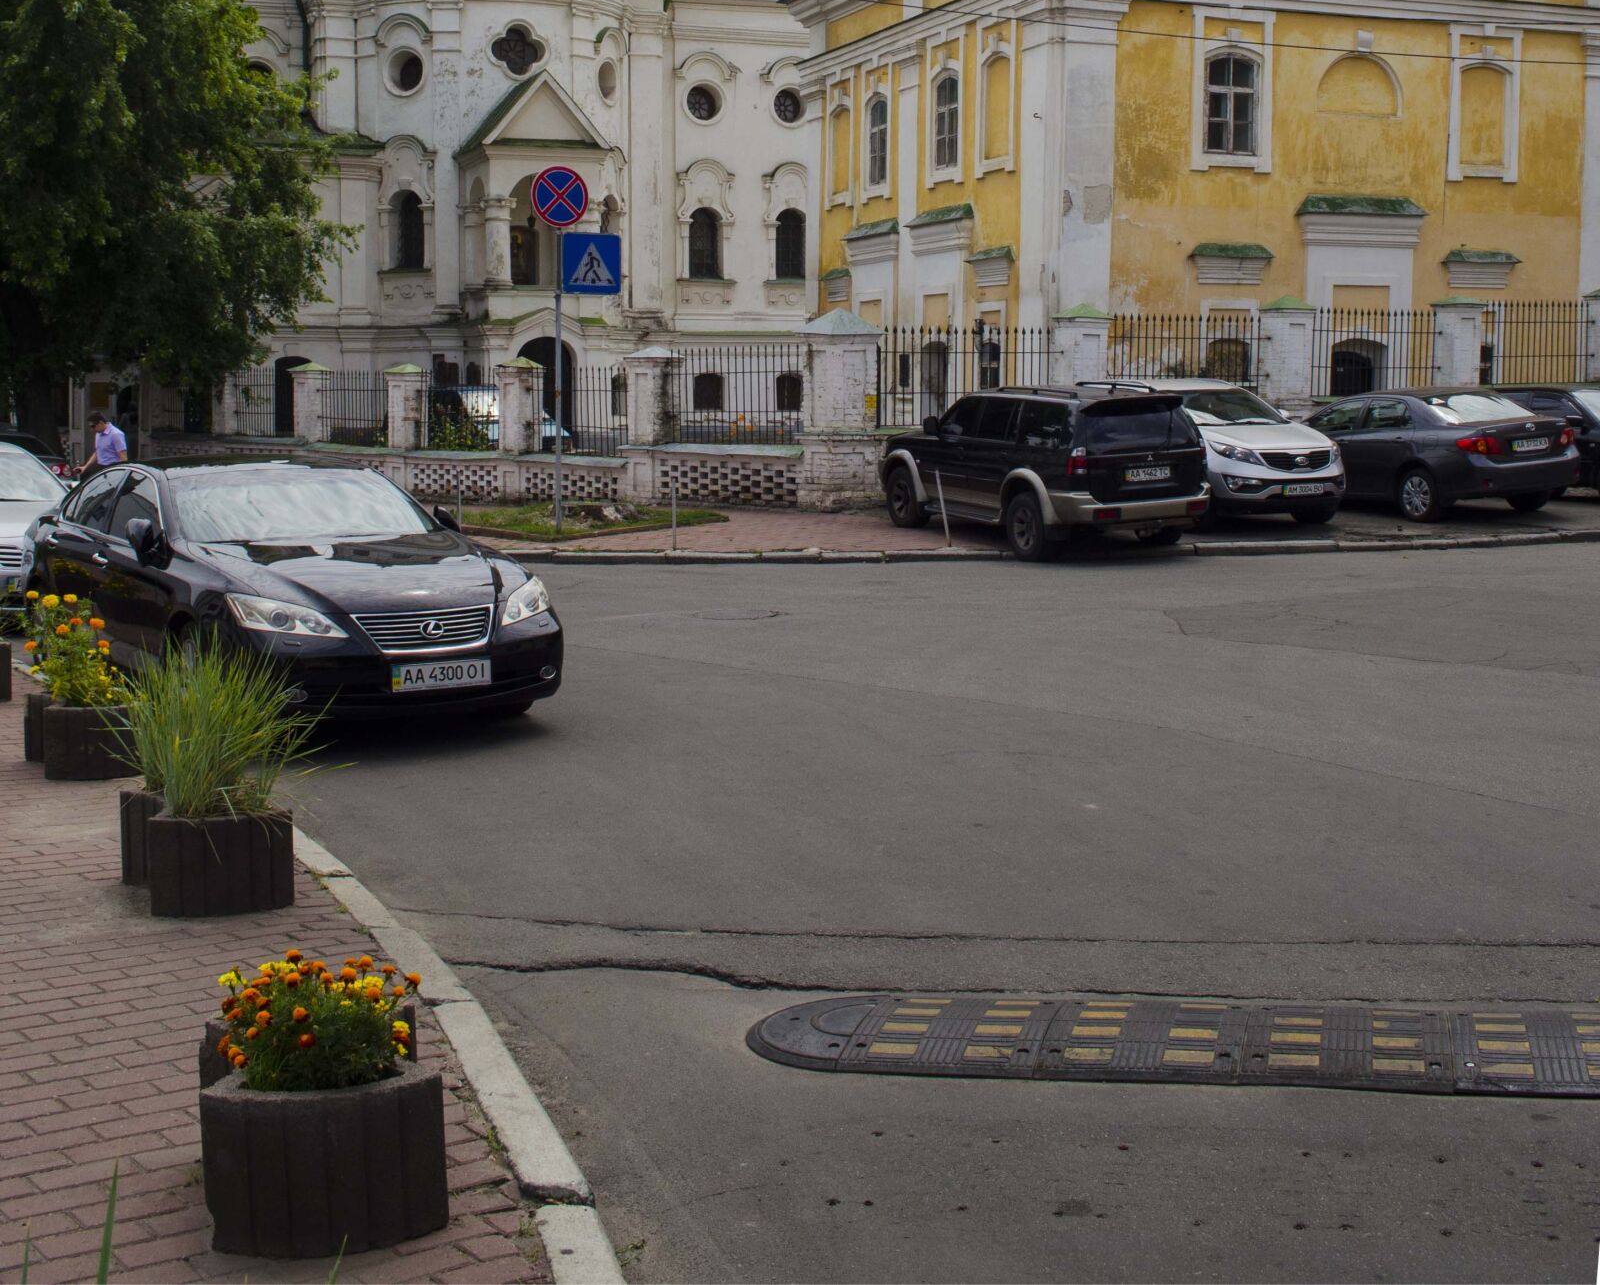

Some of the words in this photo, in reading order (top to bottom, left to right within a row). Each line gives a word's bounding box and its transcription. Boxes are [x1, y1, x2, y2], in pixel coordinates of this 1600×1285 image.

[1130, 469, 1140, 478] AA
[403, 668, 425, 684] AA
[429, 665, 463, 682] 4300
